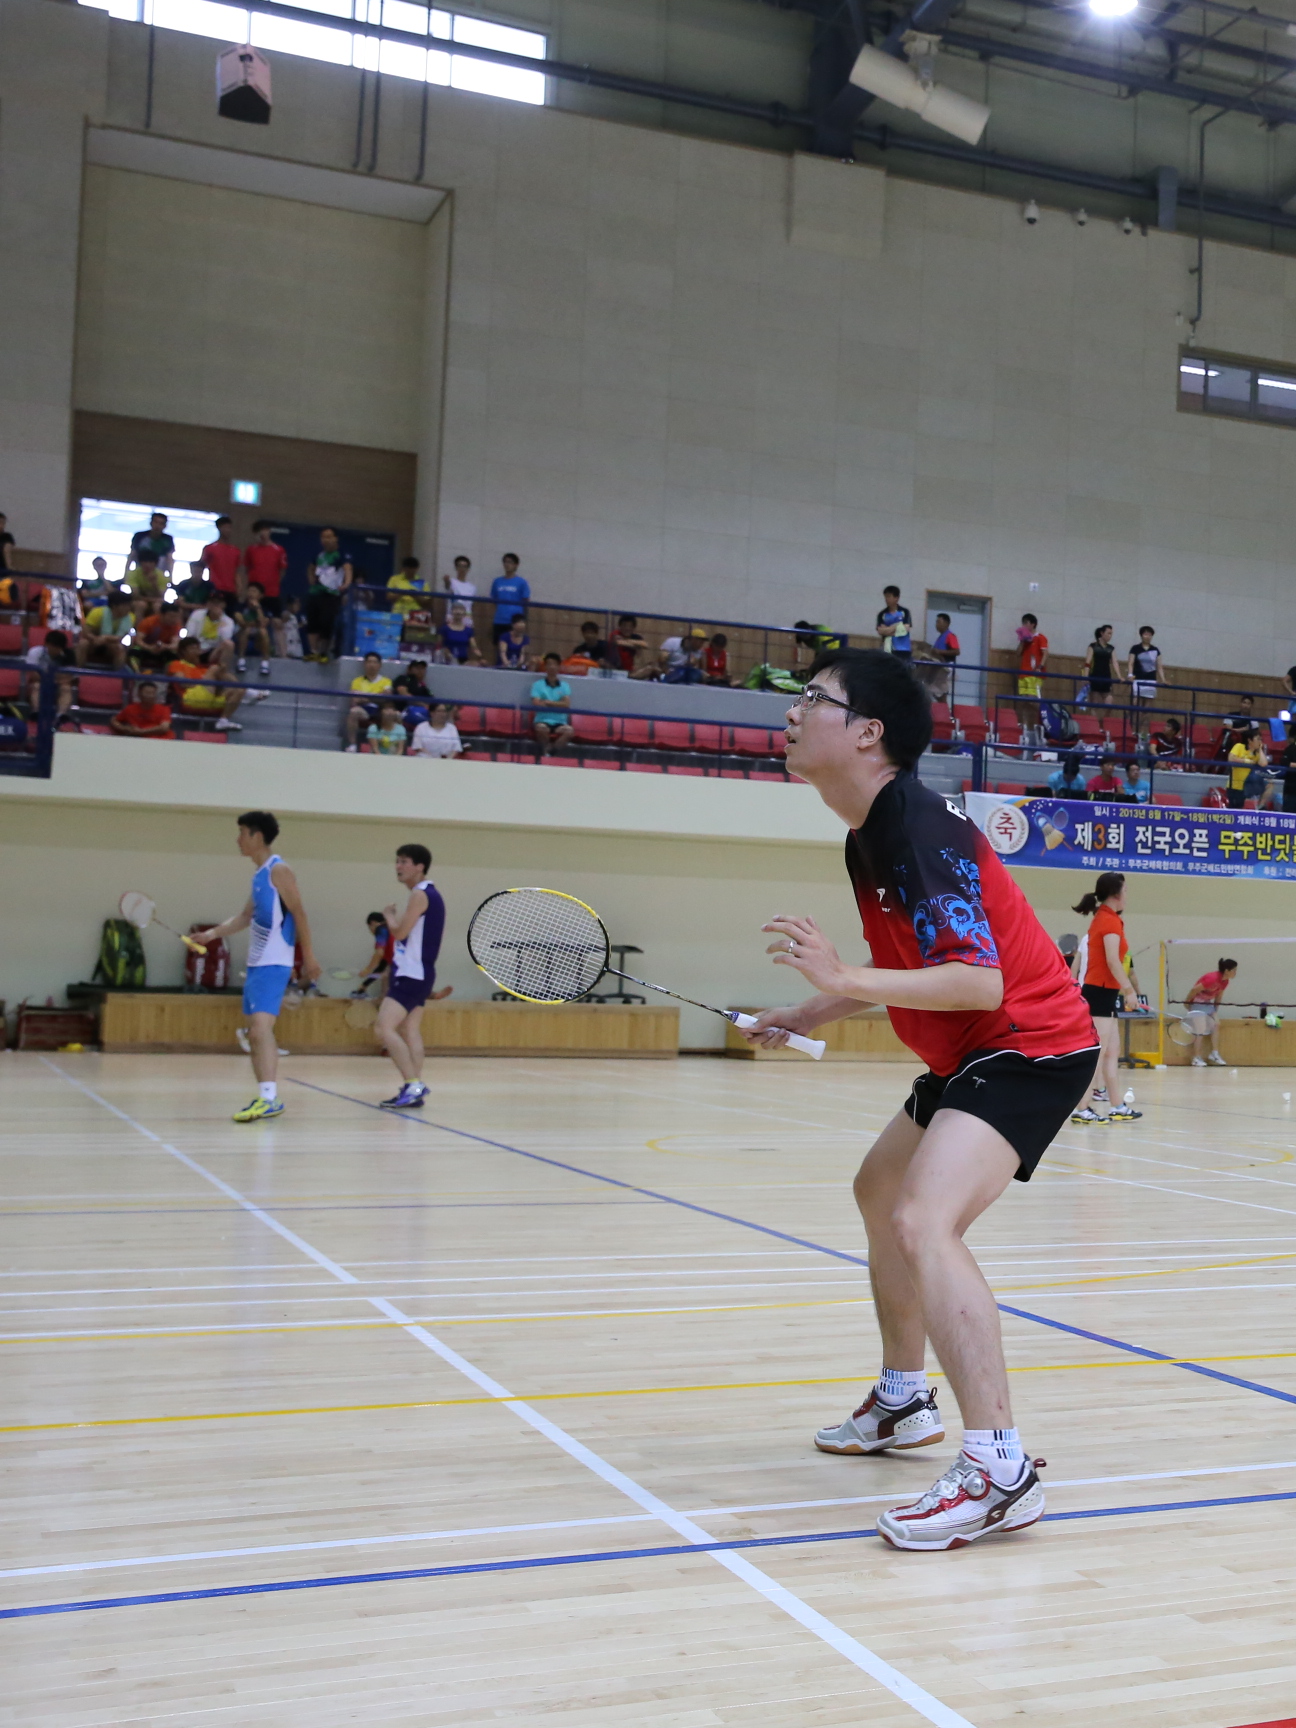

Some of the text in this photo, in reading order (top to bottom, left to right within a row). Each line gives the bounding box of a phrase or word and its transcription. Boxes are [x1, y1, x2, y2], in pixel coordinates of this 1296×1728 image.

[995, 812, 1018, 842] 축
[1094, 806, 1109, 817] 일시
[1119, 808, 1146, 819] 2013년
[1149, 809, 1161, 820] 8월
[1280, 818, 1296, 829] 18일
[1074, 821, 1124, 853] 제3회
[1134, 825, 1210, 857] 전국오픈
